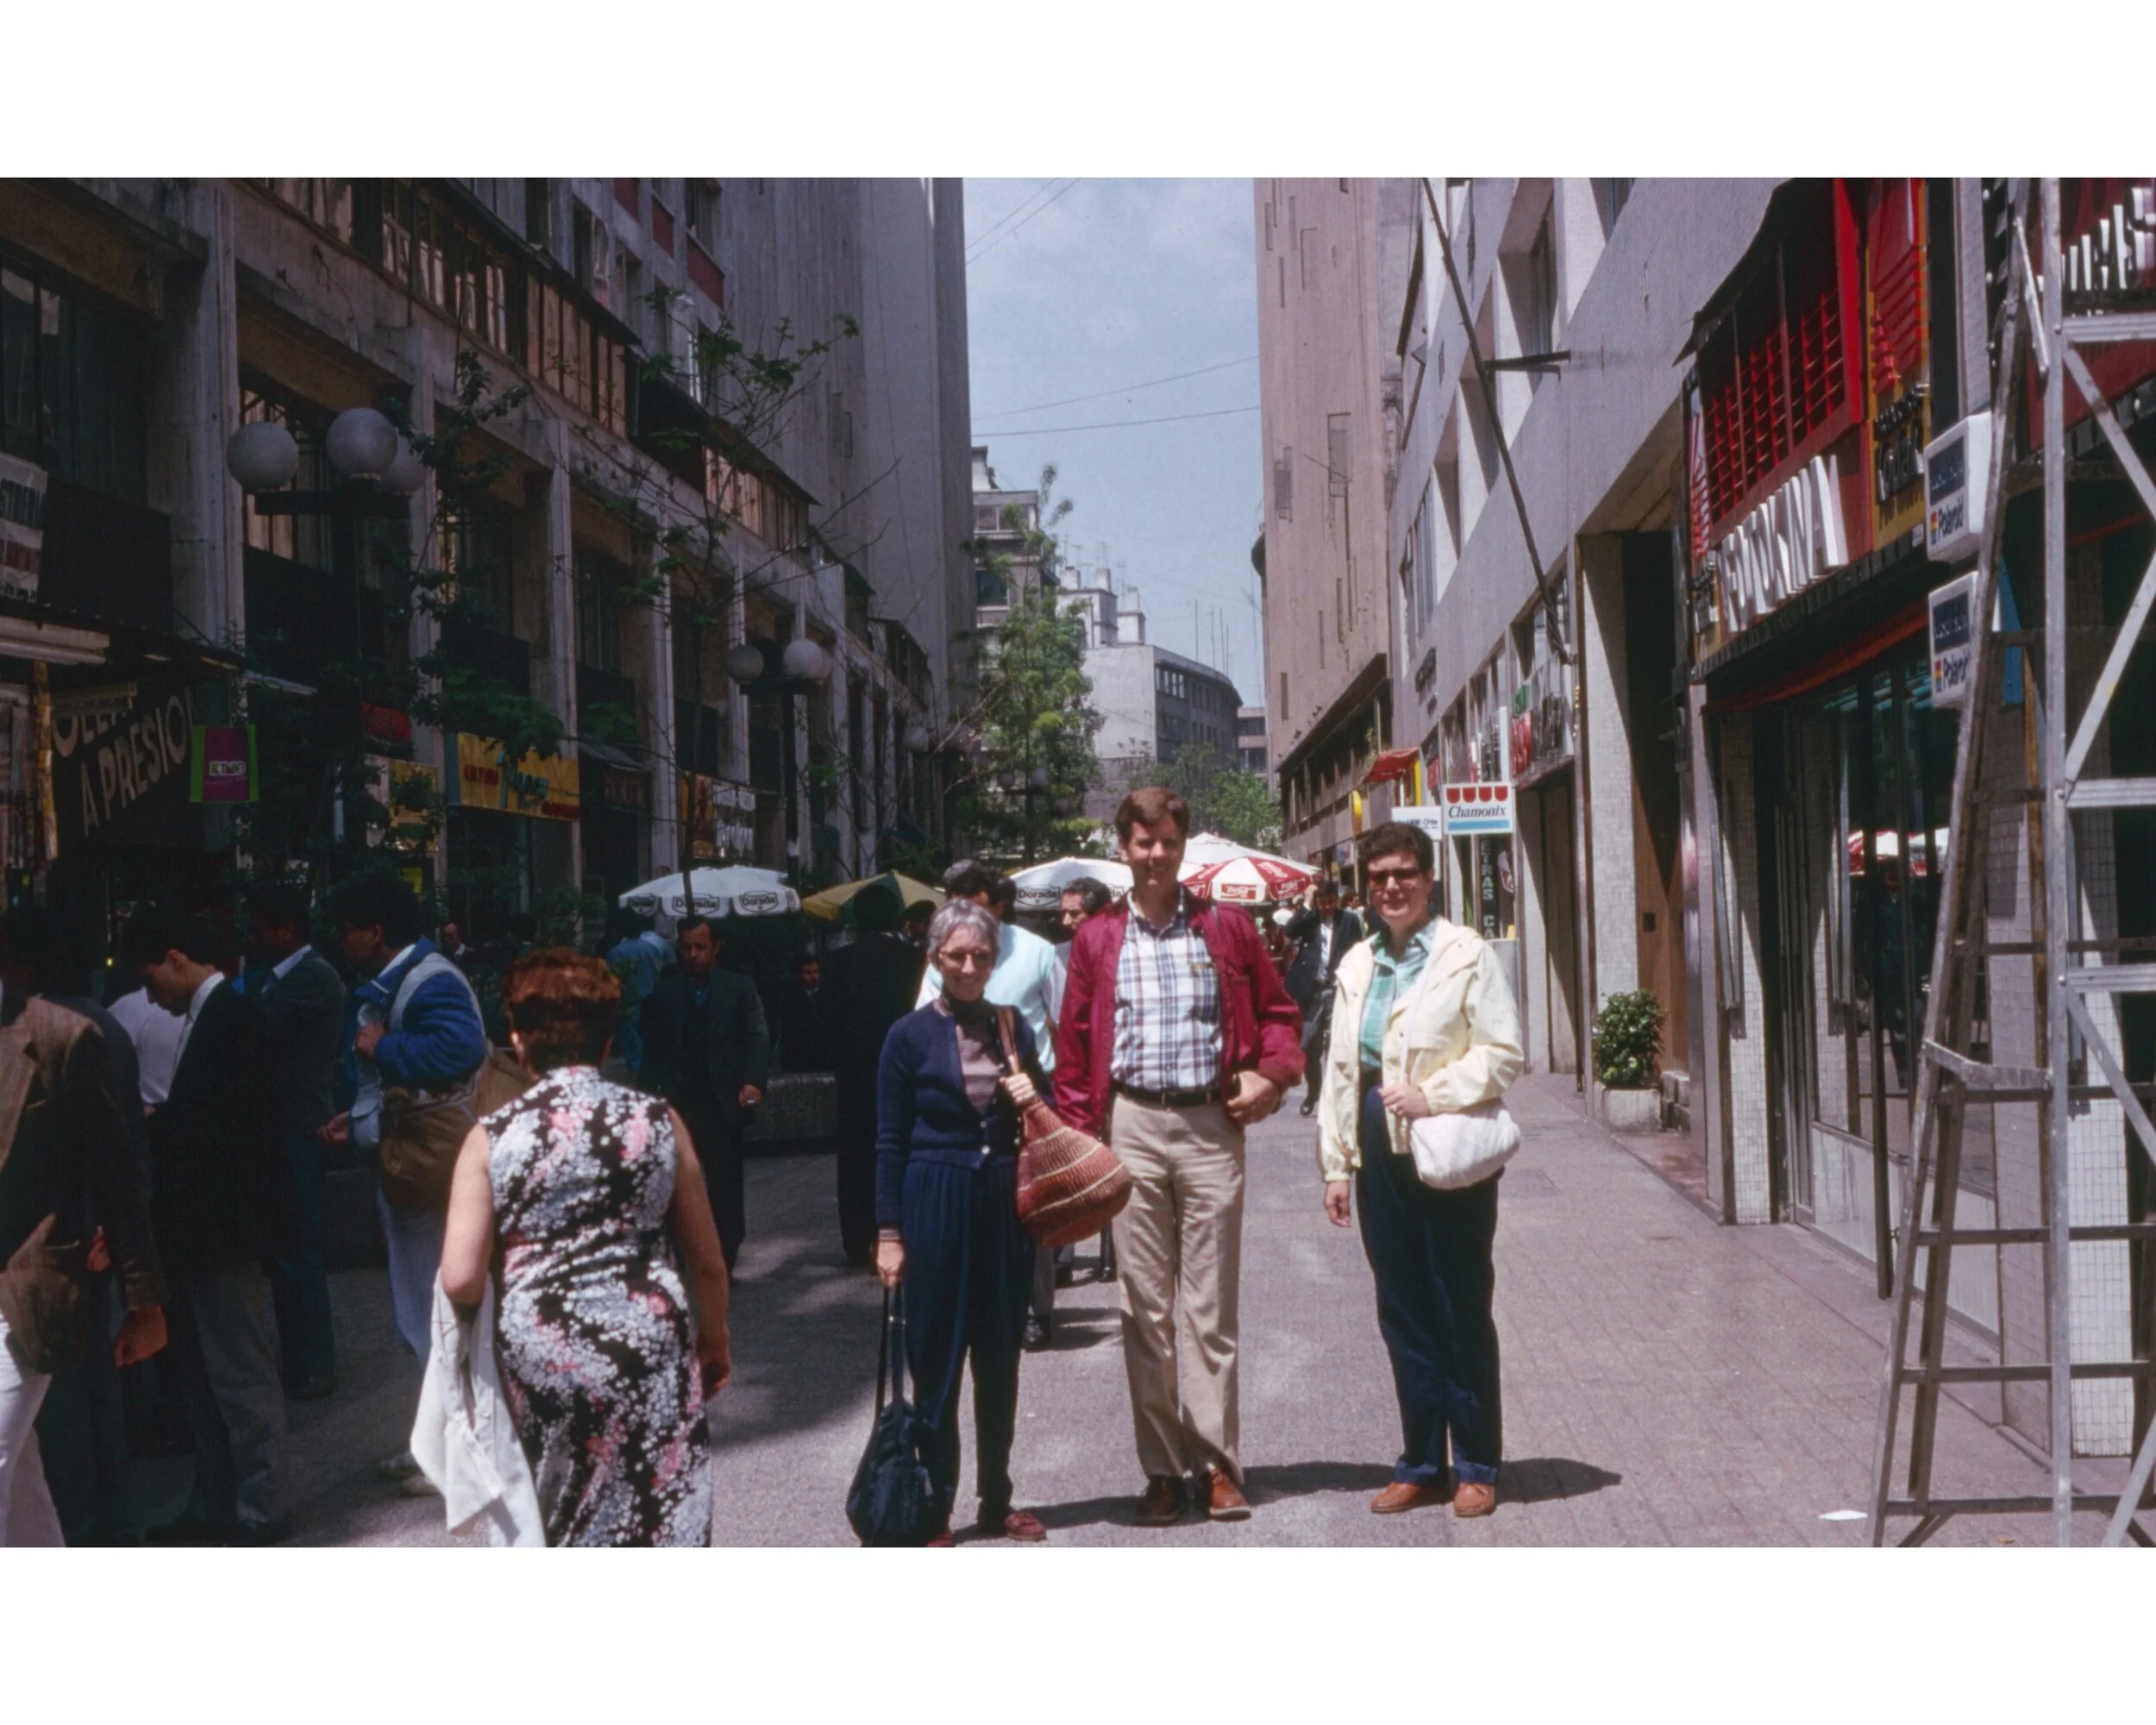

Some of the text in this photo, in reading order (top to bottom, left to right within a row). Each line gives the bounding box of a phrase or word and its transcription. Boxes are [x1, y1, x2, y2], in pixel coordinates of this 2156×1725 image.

[81, 761, 100, 838] A
[1449, 806, 1507, 819] Chamonix
[1018, 889, 1057, 899] Dorada
[743, 896, 775, 906] Dorada
